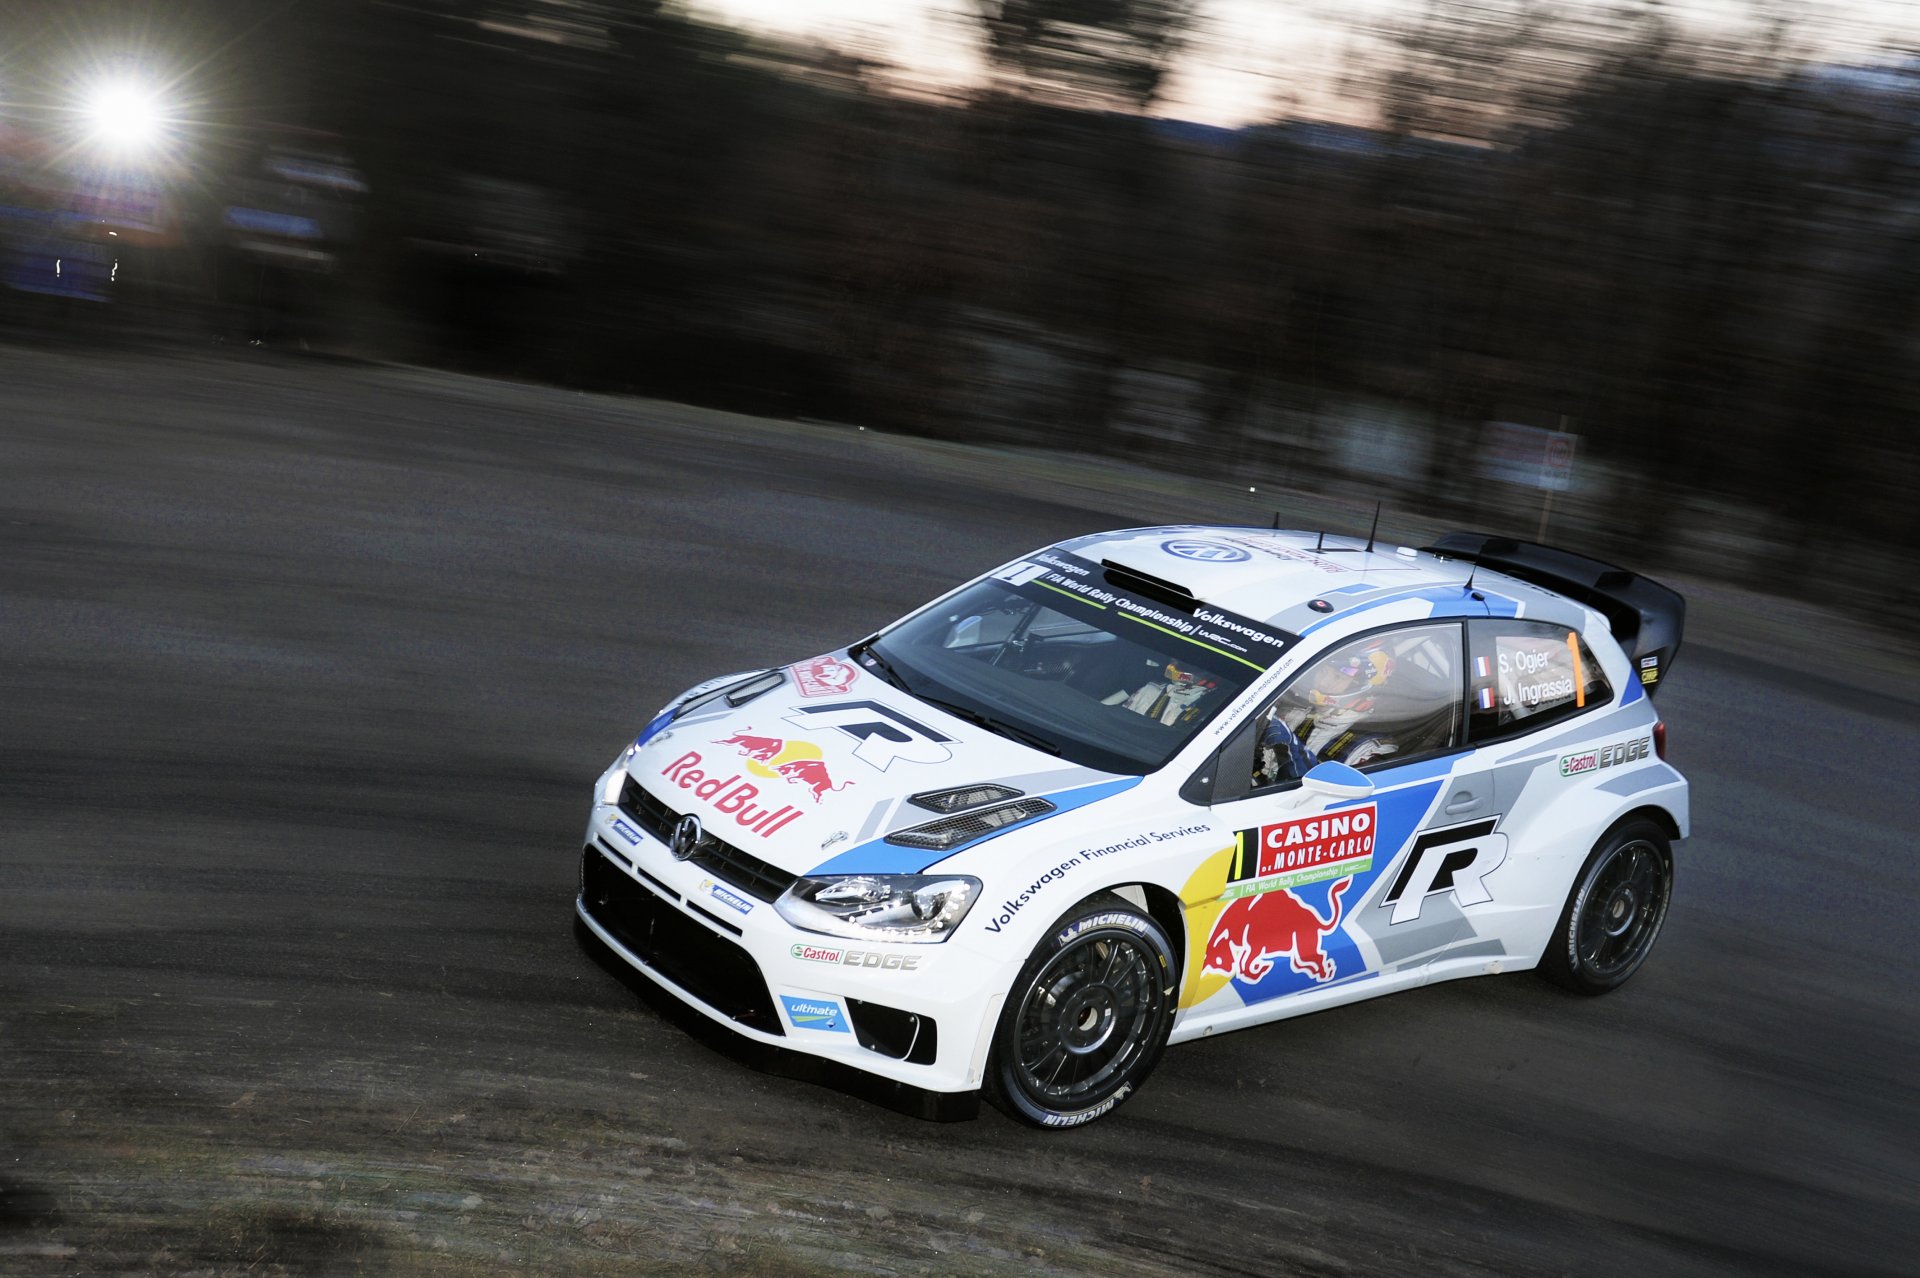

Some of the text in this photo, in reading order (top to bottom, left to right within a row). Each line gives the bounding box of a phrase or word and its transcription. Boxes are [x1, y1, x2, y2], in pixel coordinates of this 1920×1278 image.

[1035, 553, 1091, 577] Volkswagen
[1046, 573, 1066, 584] FIA
[1061, 578, 1093, 594] World
[1087, 588, 1116, 604] Rally
[1114, 598, 1194, 634] Championship
[1192, 608, 1285, 648] Volkswagen
[1498, 649, 1550, 674] S. Ogier
[1214, 658, 1295, 736] www.volkswagen-motorsport.com
[1503, 674, 1573, 706] J. Ingrassia
[1569, 736, 1650, 773] Castrol EDGE
[661, 750, 804, 839] Red Bull
[1266, 812, 1371, 849] CASINO
[1261, 864, 1272, 873] DE
[1273, 834, 1372, 871] MONTE-CARLO
[984, 822, 1211, 935] Volkswagen Financial Services
[1245, 883, 1256, 894] FIA
[1258, 880, 1278, 890] World
[1279, 876, 1295, 888] Rally
[1296, 868, 1339, 882] Championship
[714, 888, 752, 912] MICHELIN
[1078, 912, 1148, 937] MICHELIN
[1568, 888, 1585, 956] MICHELIN
[803, 946, 923, 971] Castrol EDGE
[790, 1002, 838, 1018] ultimate
[1043, 1101, 1116, 1128] MICHELIN
